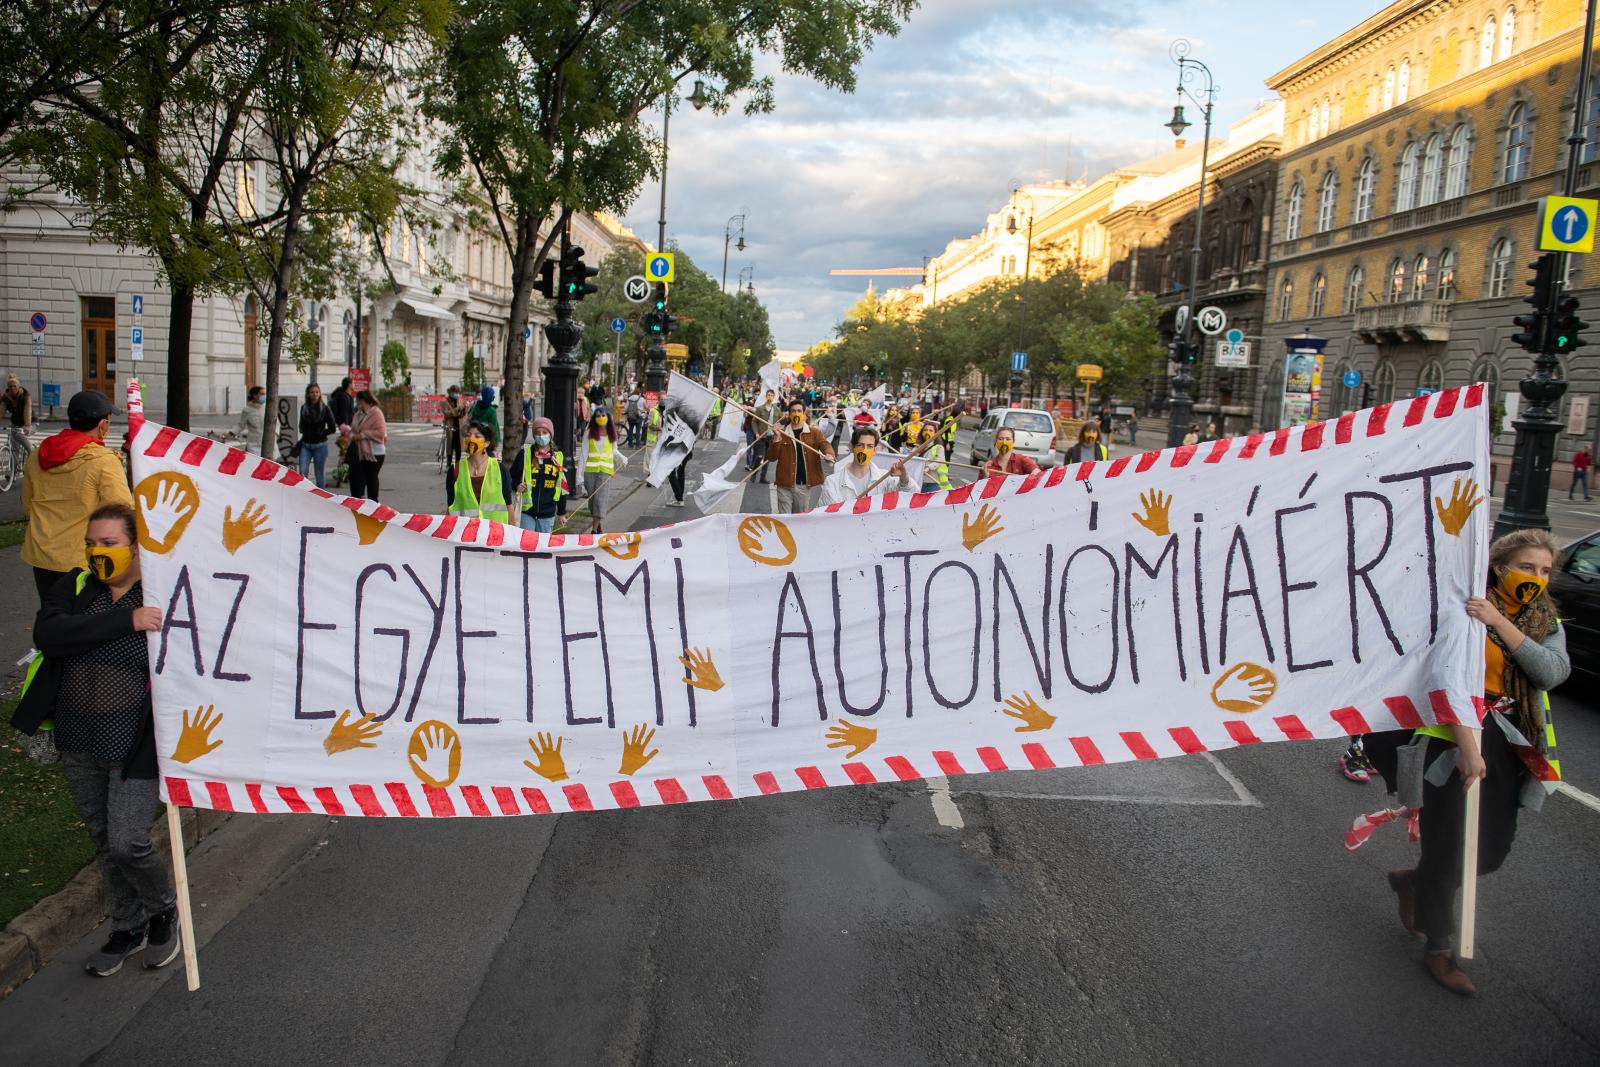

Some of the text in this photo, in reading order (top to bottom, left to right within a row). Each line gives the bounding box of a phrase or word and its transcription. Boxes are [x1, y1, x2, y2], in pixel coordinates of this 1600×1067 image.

[630, 281, 645, 297] M
[1204, 312, 1220, 329] M
[133, 330, 141, 342] P
[155, 564, 251, 682] AZ
